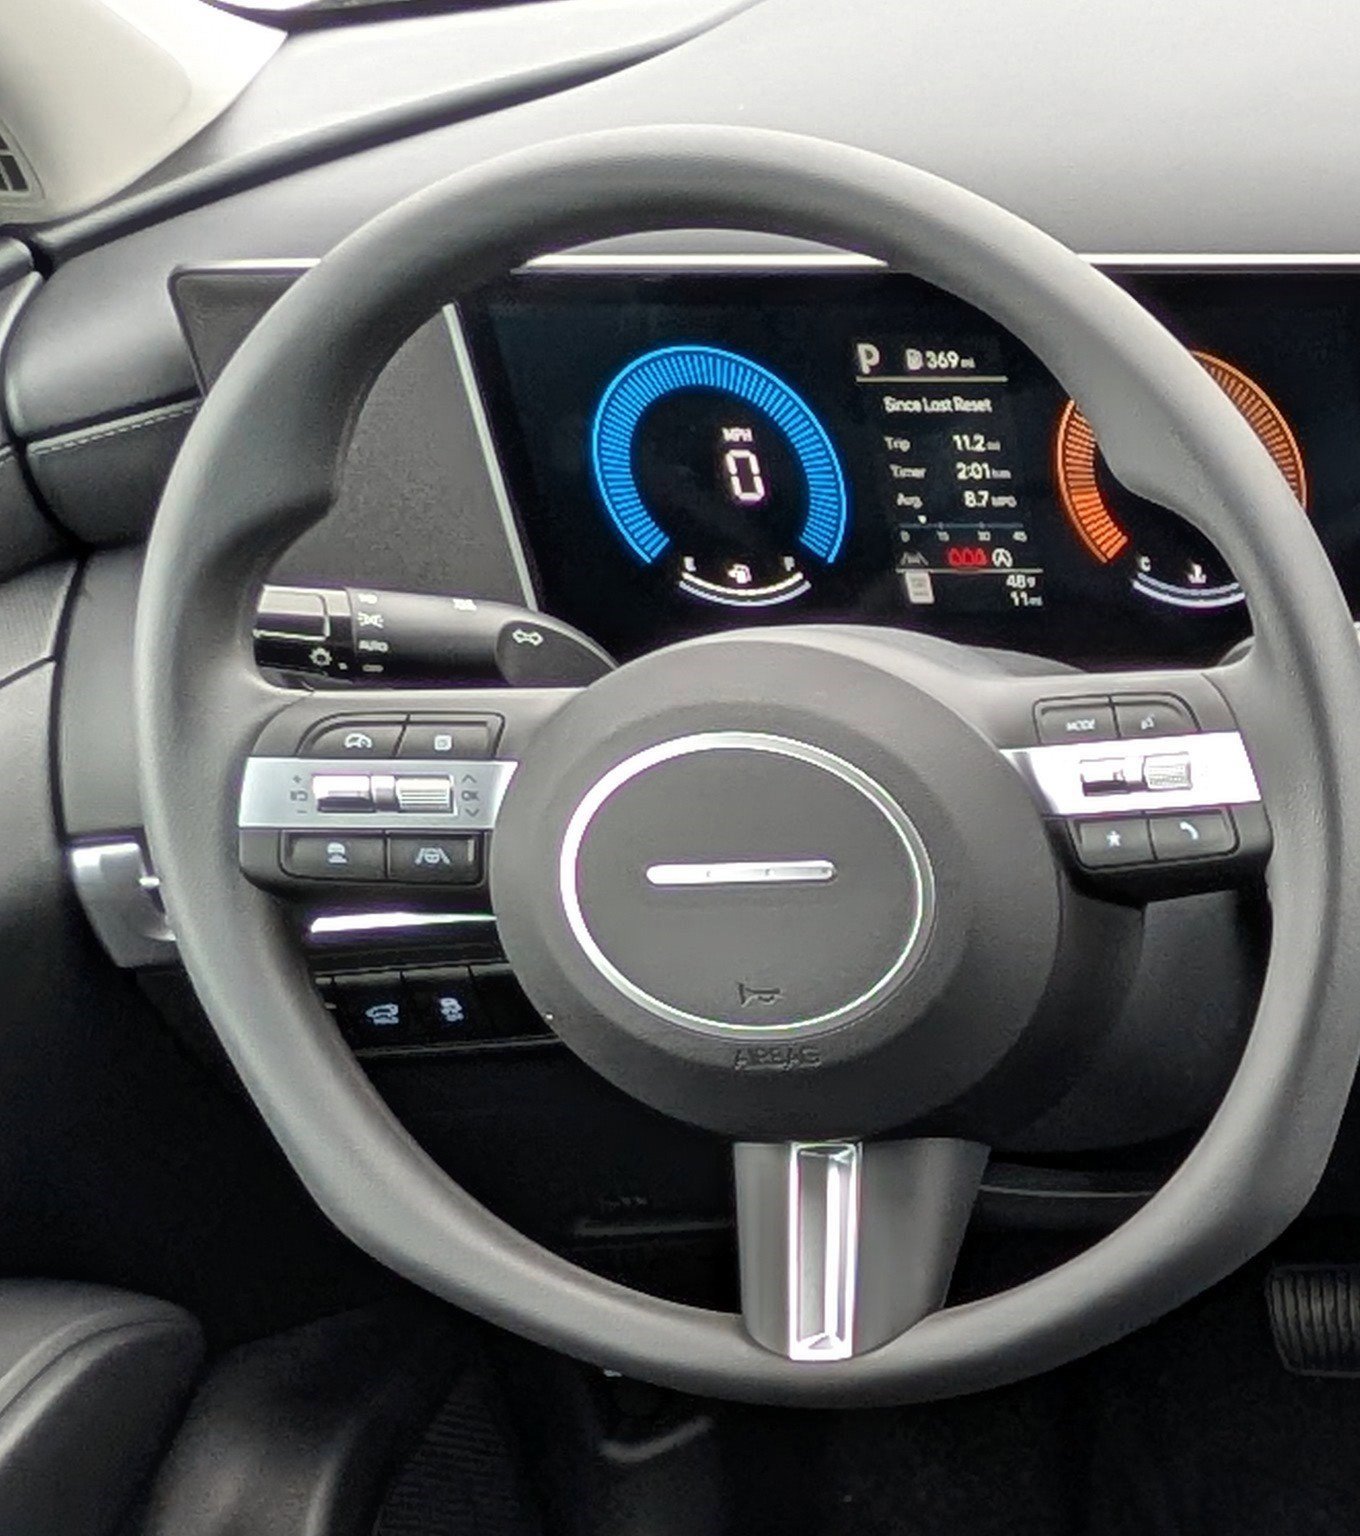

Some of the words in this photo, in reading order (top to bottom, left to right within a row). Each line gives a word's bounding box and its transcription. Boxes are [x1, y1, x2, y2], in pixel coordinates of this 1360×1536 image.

[857, 343, 880, 374] P
[925, 351, 960, 369] 369
[883, 396, 921, 413] Since
[923, 397, 952, 413] Last
[953, 396, 993, 413] Reset
[722, 427, 753, 443] MPH
[952, 434, 987, 452] 11.2
[725, 449, 765, 501] 0
[956, 462, 991, 480] 2:01
[964, 490, 990, 508] 8.7
